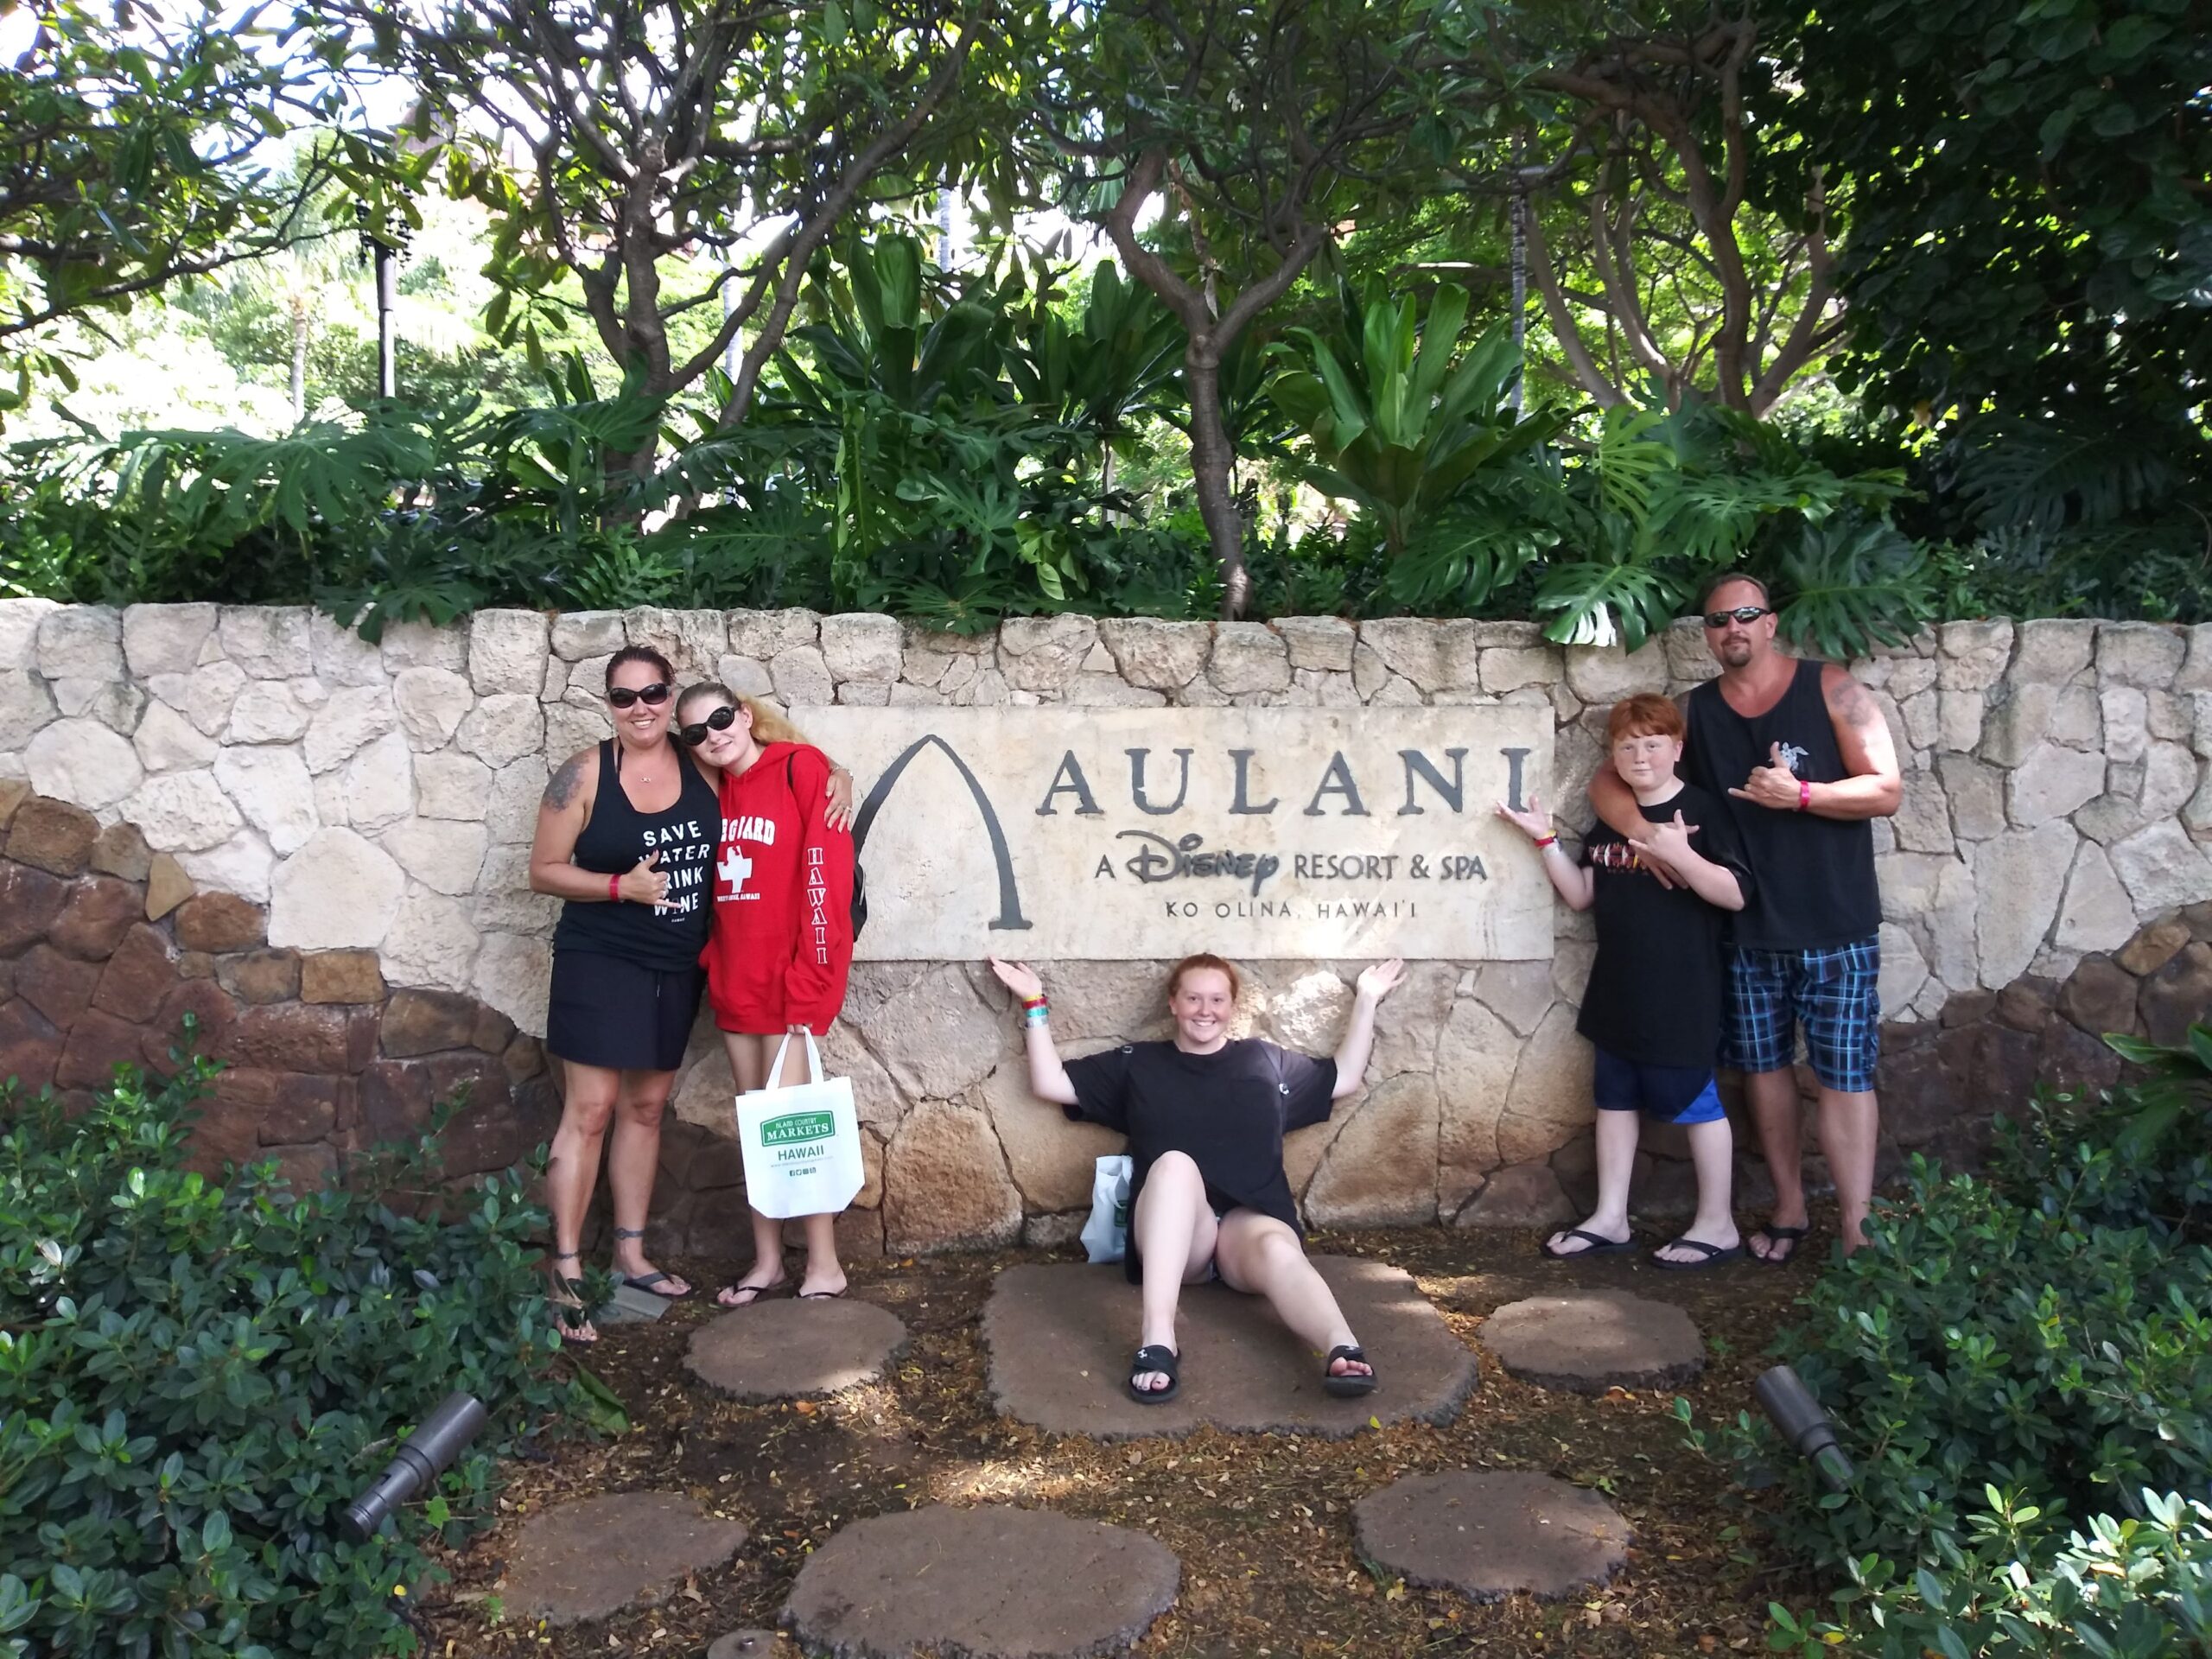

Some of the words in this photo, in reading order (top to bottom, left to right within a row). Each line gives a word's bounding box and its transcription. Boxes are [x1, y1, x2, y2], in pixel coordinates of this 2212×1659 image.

[1035, 748, 1531, 816] AULANI
[643, 821, 702, 847] SAVE
[1095, 855, 1116, 879] A
[1116, 830, 1280, 897] Disney
[1295, 855, 1400, 880] RESORT
[1410, 855, 1431, 880] &
[1440, 855, 1488, 881] SPA
[666, 866, 703, 890] RINK
[807, 848, 828, 964] HAWAII
[1166, 902, 1198, 918] KO
[1215, 902, 1301, 919] OLINA,
[767, 1122, 830, 1141] MARKETS
[795, 1117, 817, 1127] COUNTRY
[778, 1145, 824, 1161] HAWAII
